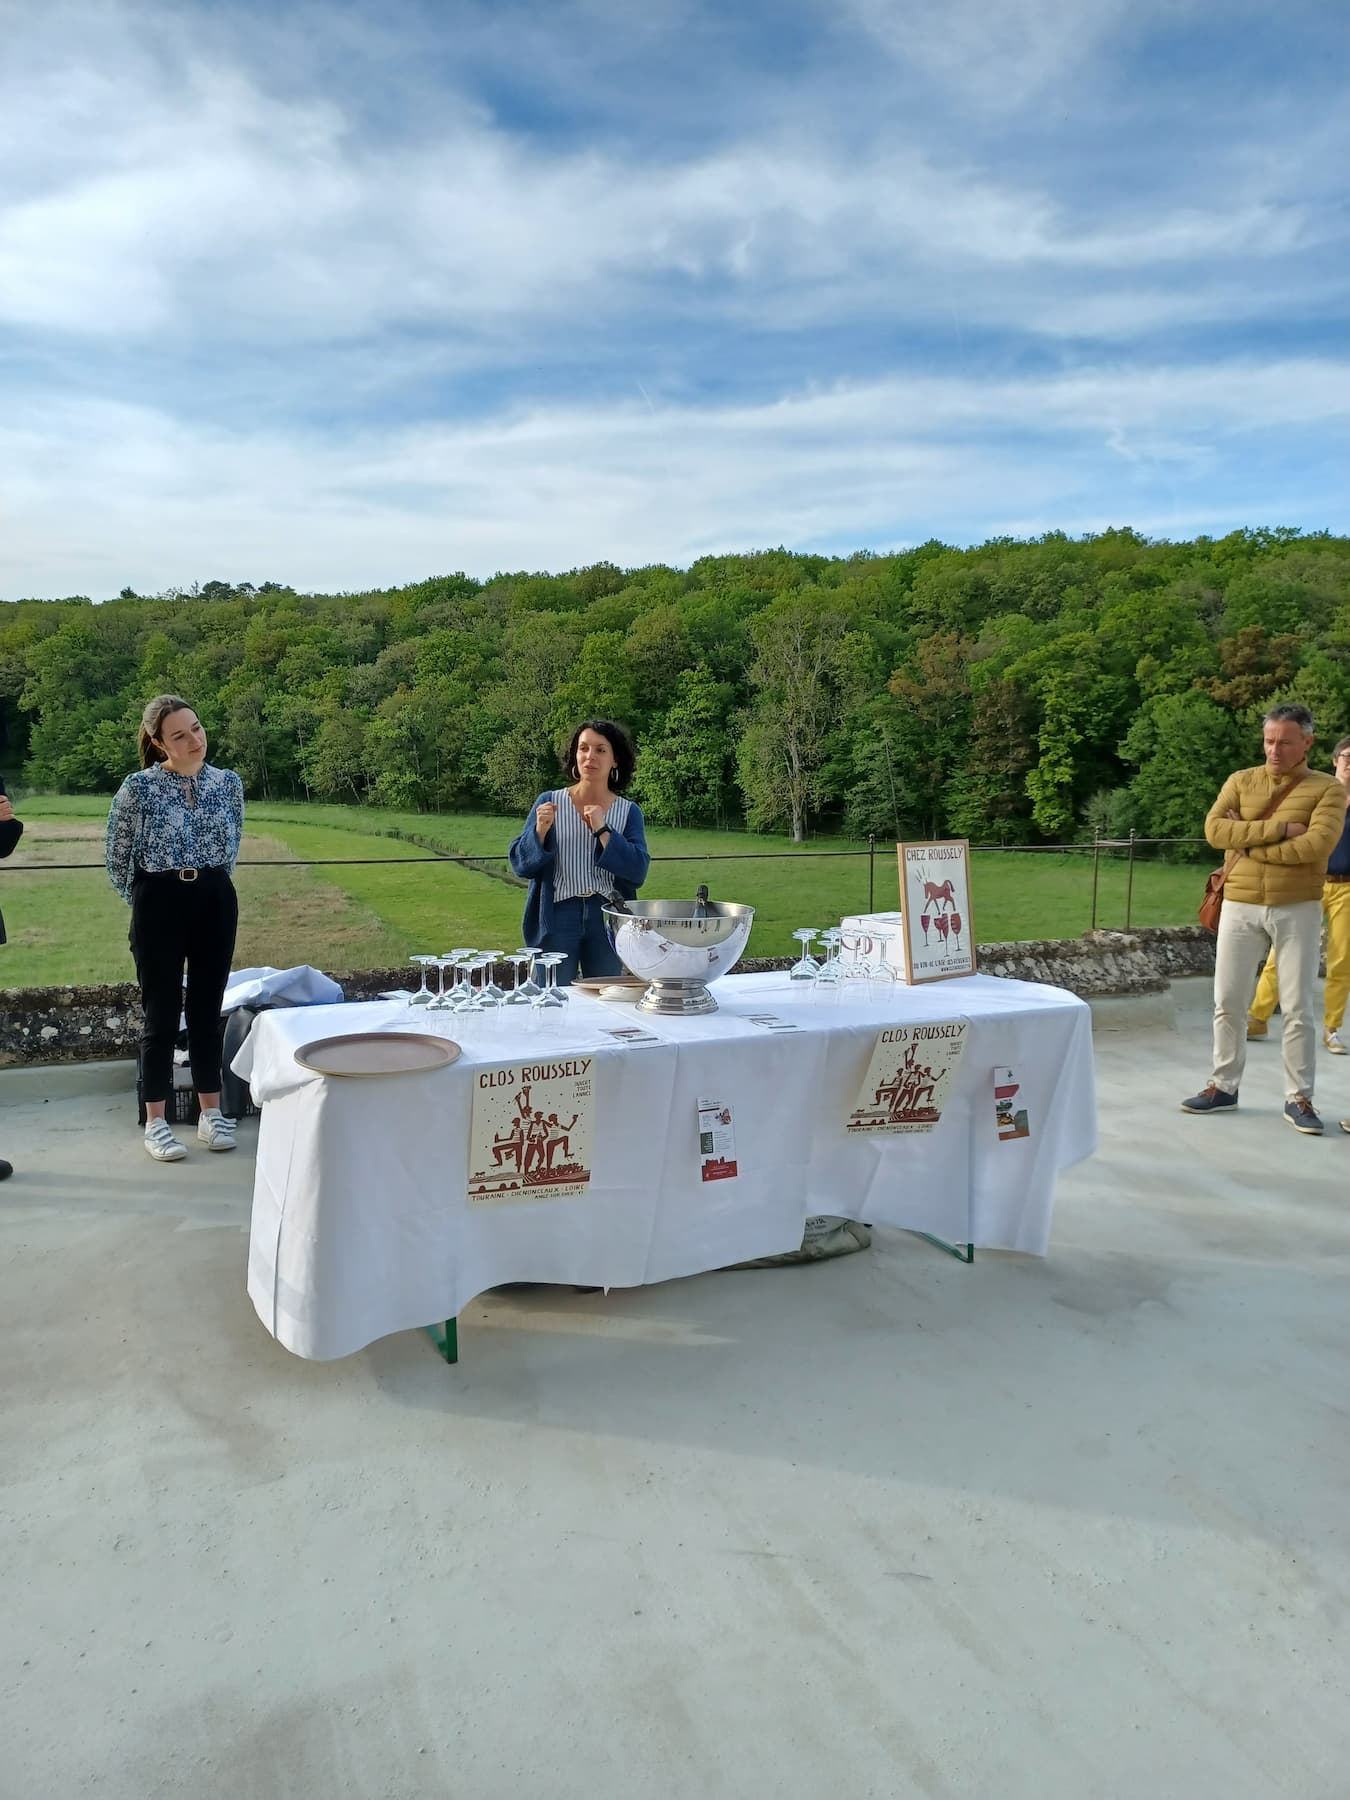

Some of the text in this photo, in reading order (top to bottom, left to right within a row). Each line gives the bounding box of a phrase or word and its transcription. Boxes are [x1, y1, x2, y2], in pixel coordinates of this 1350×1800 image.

[906, 848, 963, 861] CHEZ ROUSSELY
[881, 1024, 966, 1043] CLOS ROUSSELY
[480, 1059, 592, 1088] CLOS ROUSSELY
[472, 1193, 505, 1201] TOURAINE
[511, 1187, 559, 1197] CHENONCEAUX
